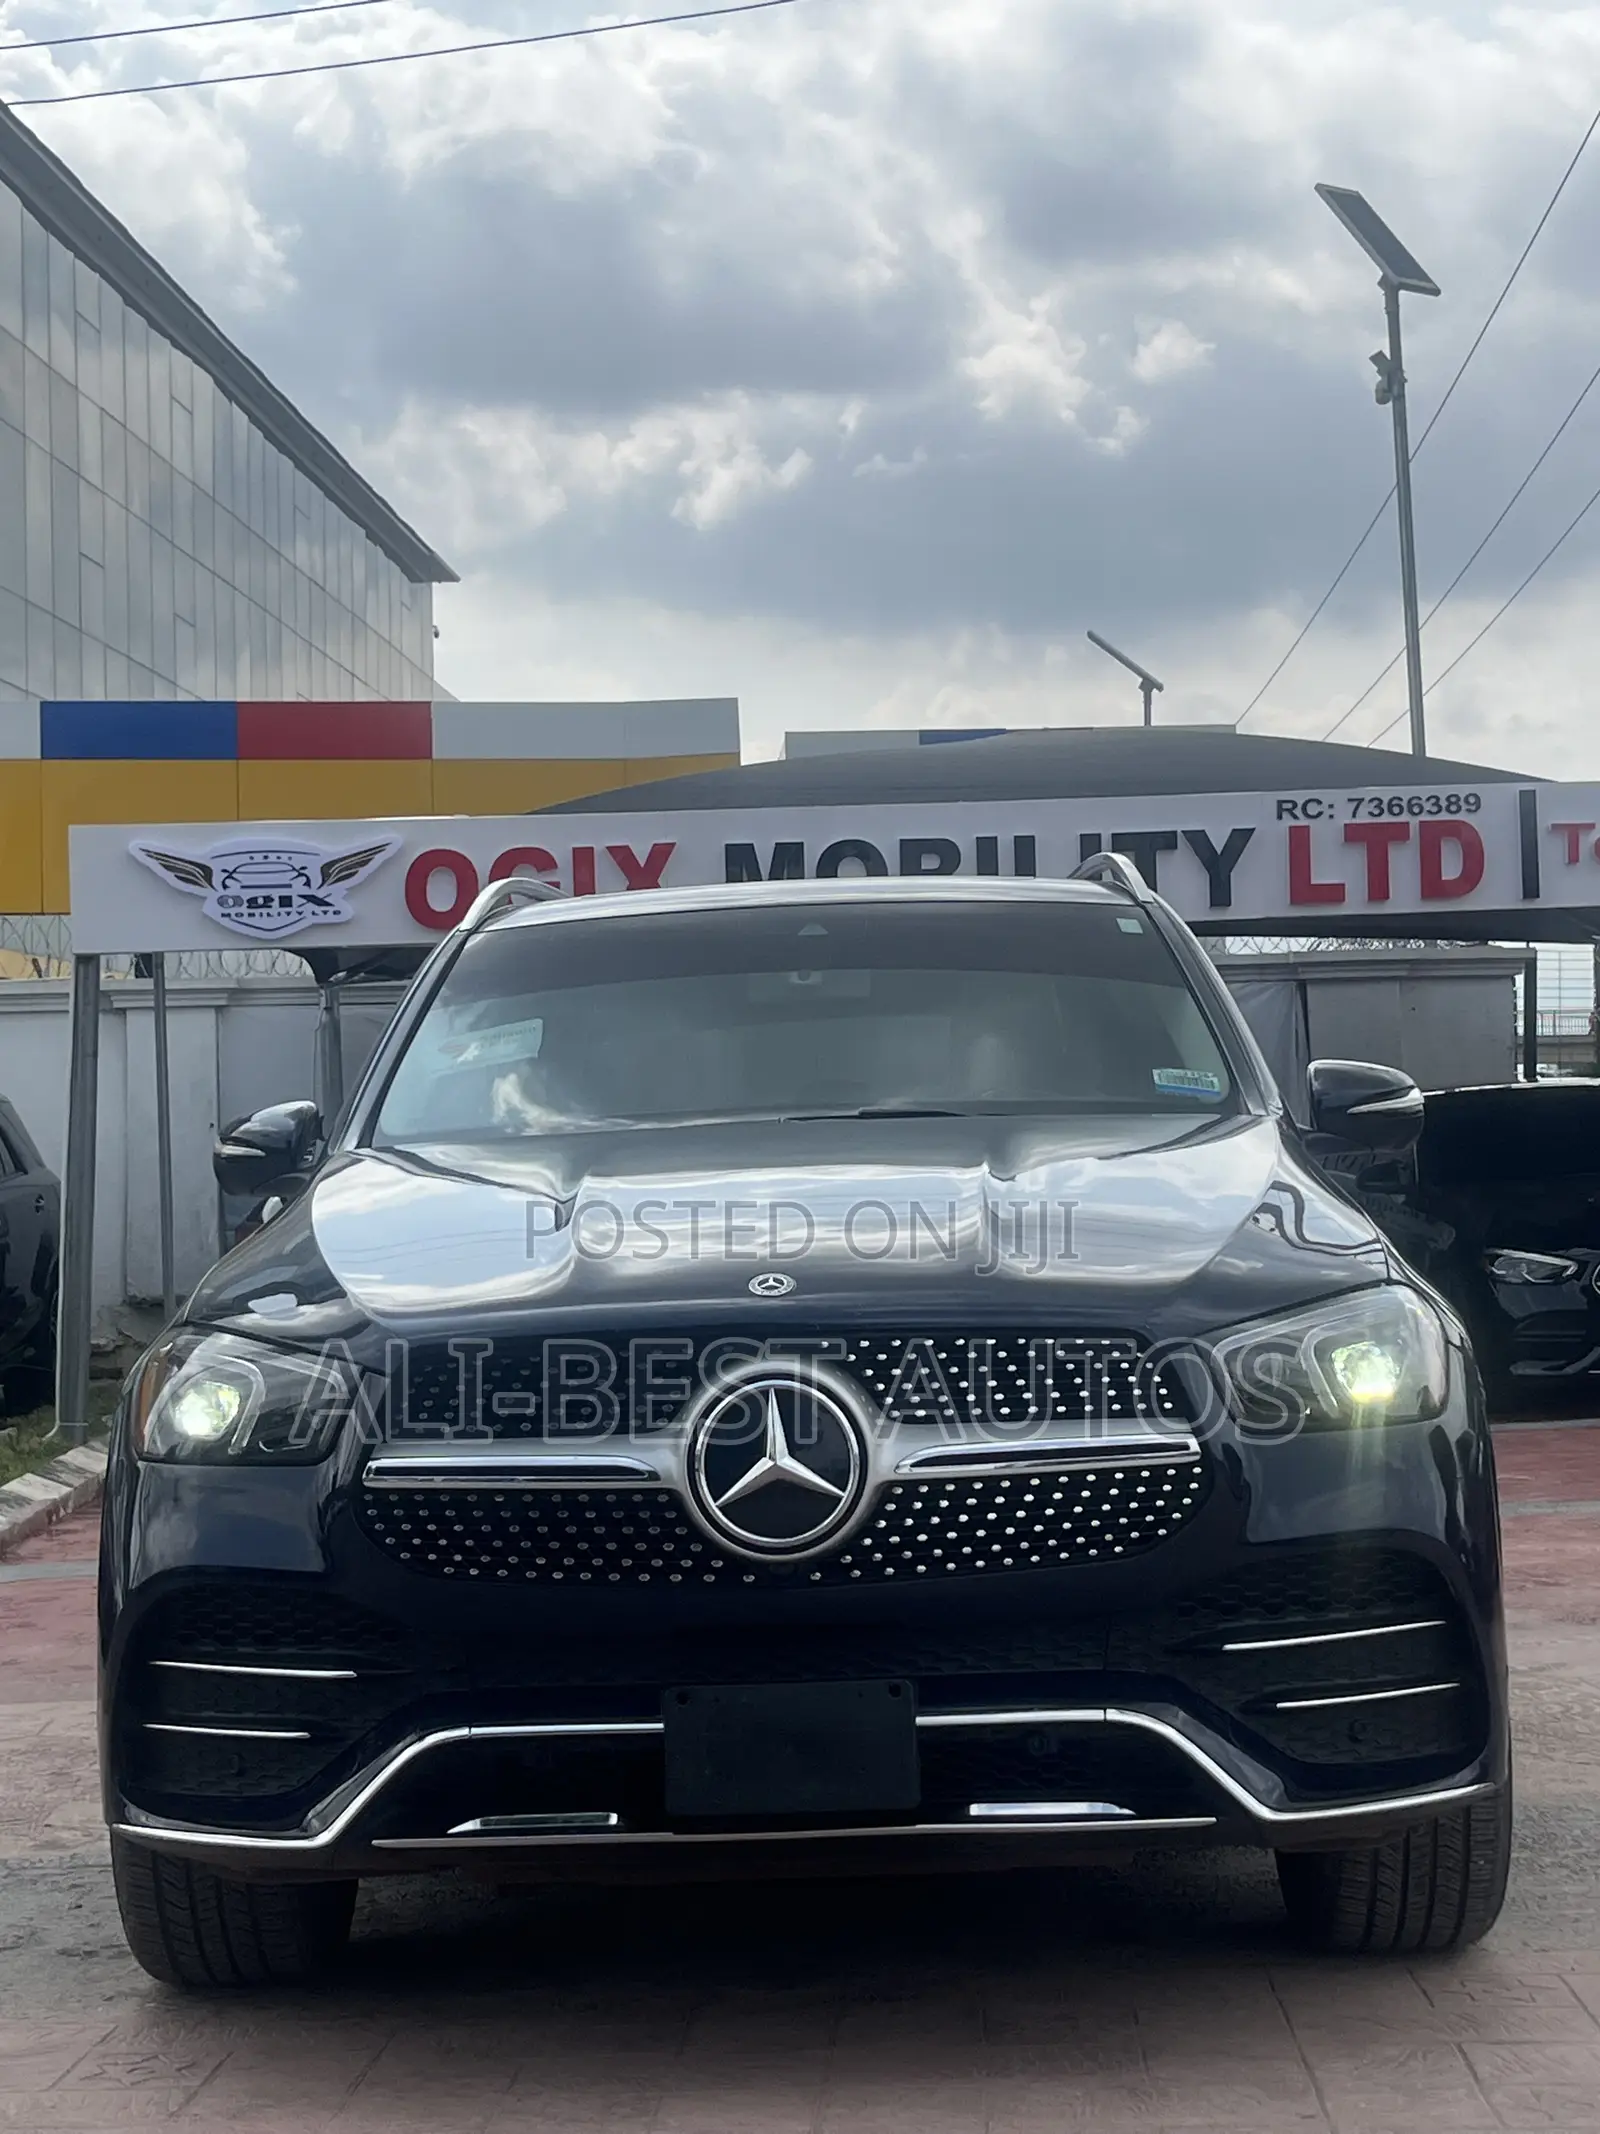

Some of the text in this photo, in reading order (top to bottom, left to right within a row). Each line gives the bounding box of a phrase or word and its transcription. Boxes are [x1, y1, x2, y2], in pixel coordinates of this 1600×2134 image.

[1276, 792, 1482, 820] RC: 7366389
[1550, 822, 1600, 866] T
[1287, 820, 1486, 906] LTD
[221, 910, 304, 918] MOBILITY
